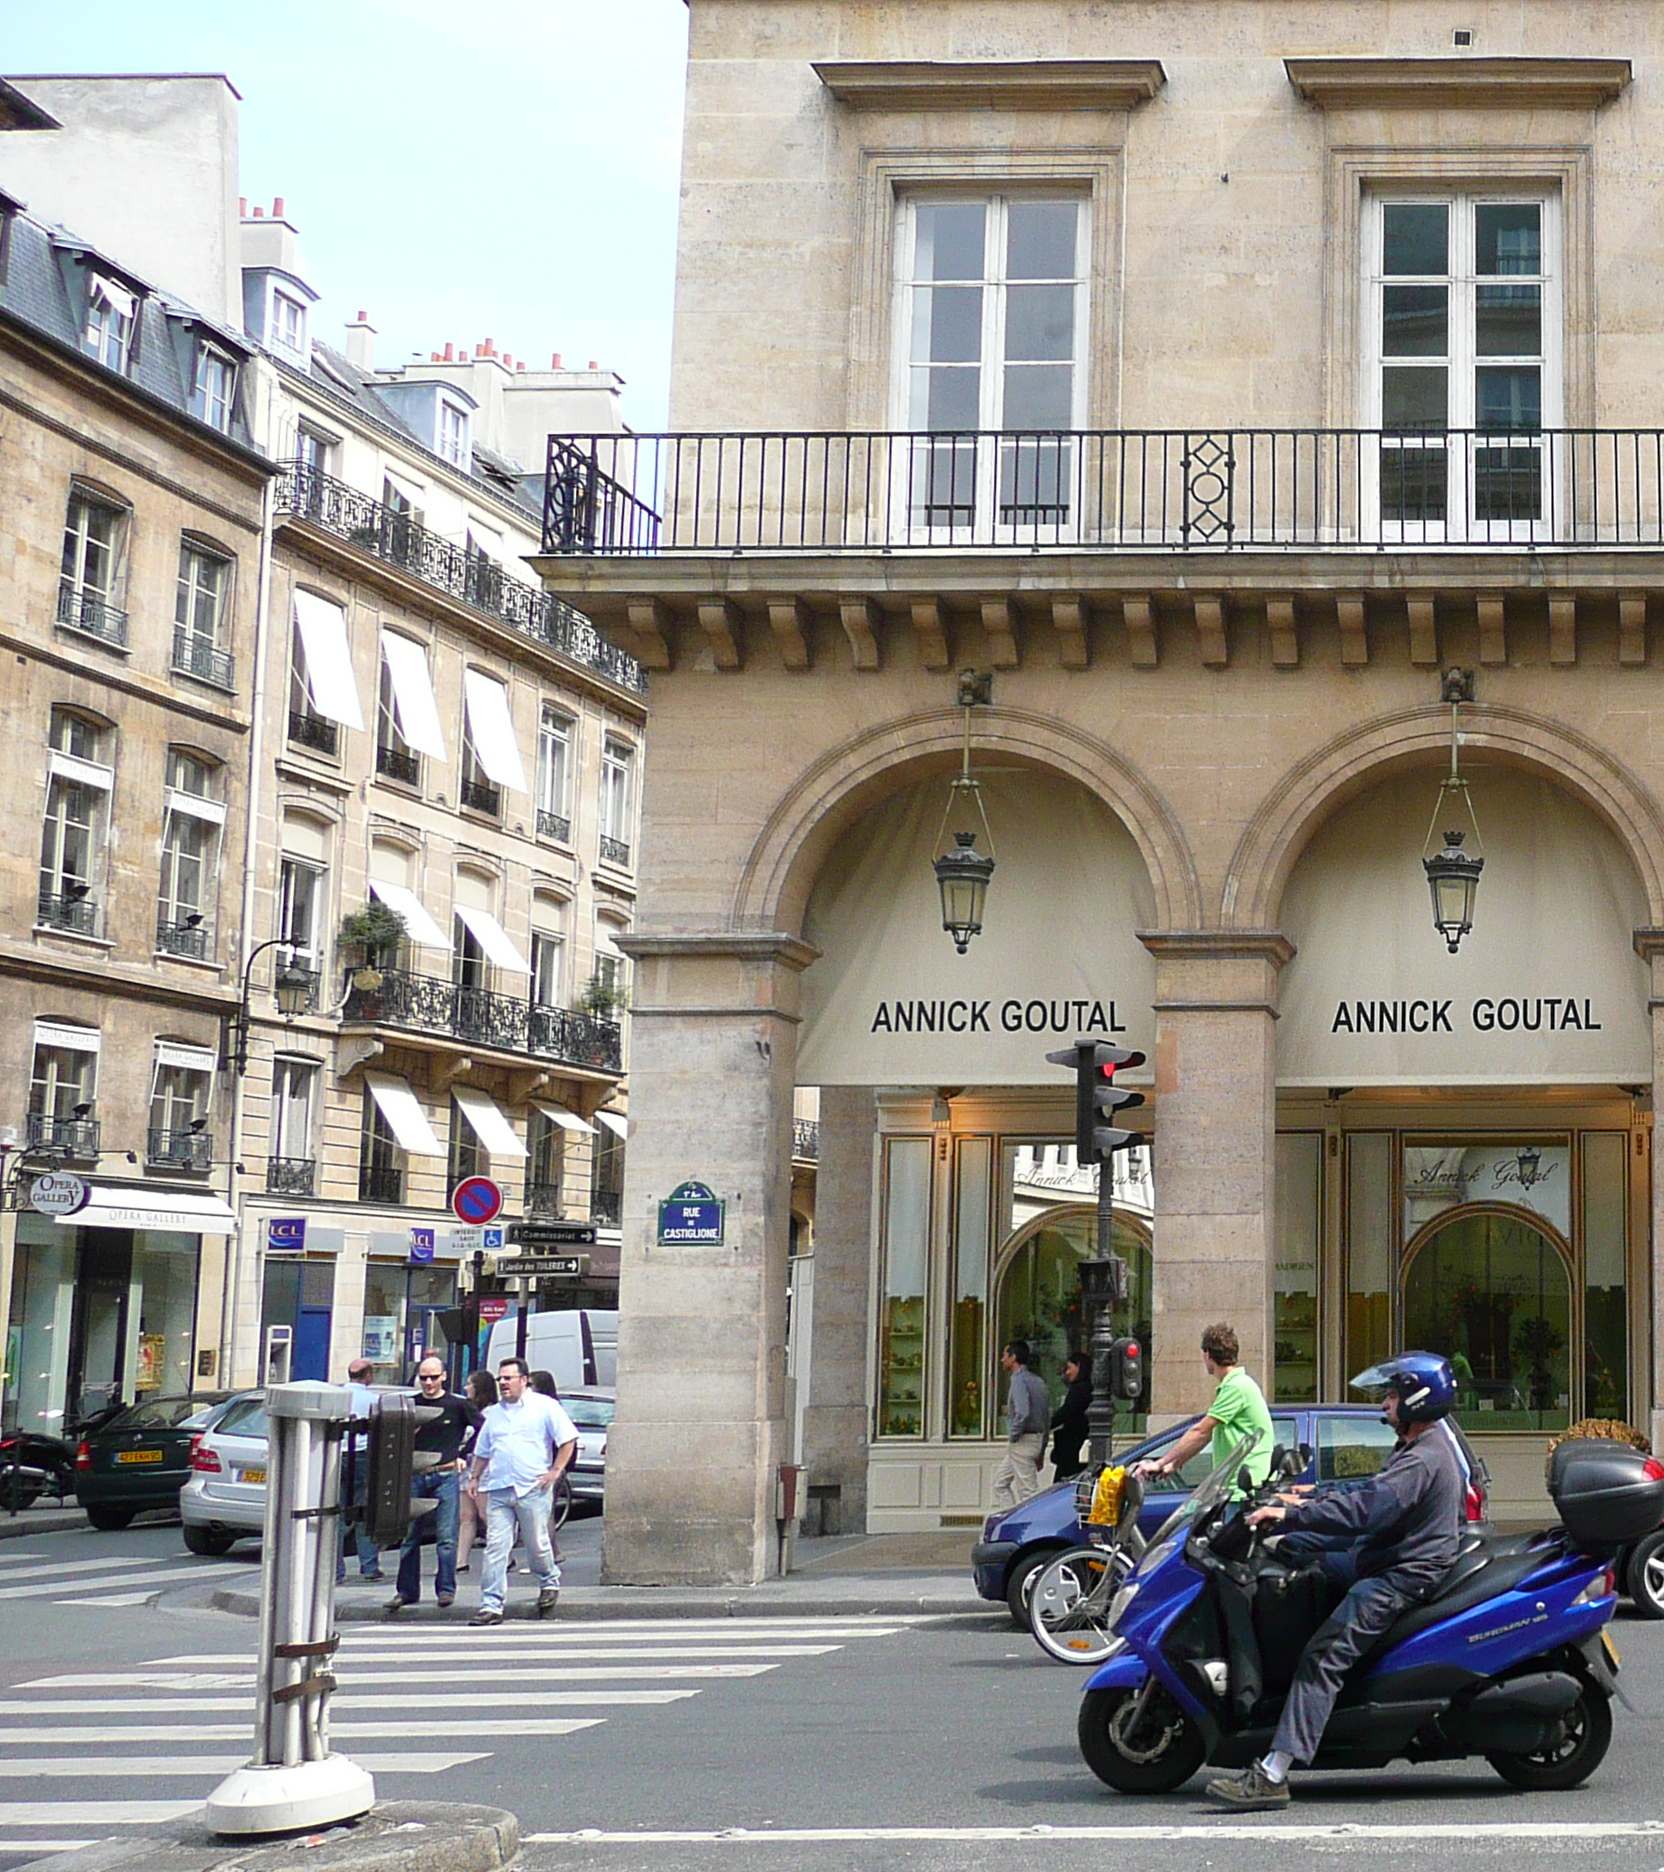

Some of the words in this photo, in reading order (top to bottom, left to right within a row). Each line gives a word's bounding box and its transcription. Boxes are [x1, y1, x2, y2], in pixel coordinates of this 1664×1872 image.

[871, 1000, 992, 1033] ANNICK
[1001, 1000, 1127, 1032] GOUTAL
[1331, 1000, 1454, 1033] ANNICK
[1472, 998, 1602, 1031] GOUTAL
[1014, 1163, 1080, 1187] Annick
[1089, 1165, 1152, 1194] Gutal
[1414, 1159, 1486, 1184] Annick
[1491, 1160, 1558, 1190] Goutal
[40, 1175, 79, 1191] OPERA
[33, 1190, 80, 1206] GALLERY
[109, 1209, 142, 1222] OPERA
[146, 1212, 187, 1224] GALLERY
[683, 1207, 701, 1217] RUE
[270, 1225, 300, 1236] LCL
[523, 1229, 575, 1240] Commissariat
[663, 1228, 718, 1239] CASTIGLIONE
[412, 1234, 432, 1247] LCL
